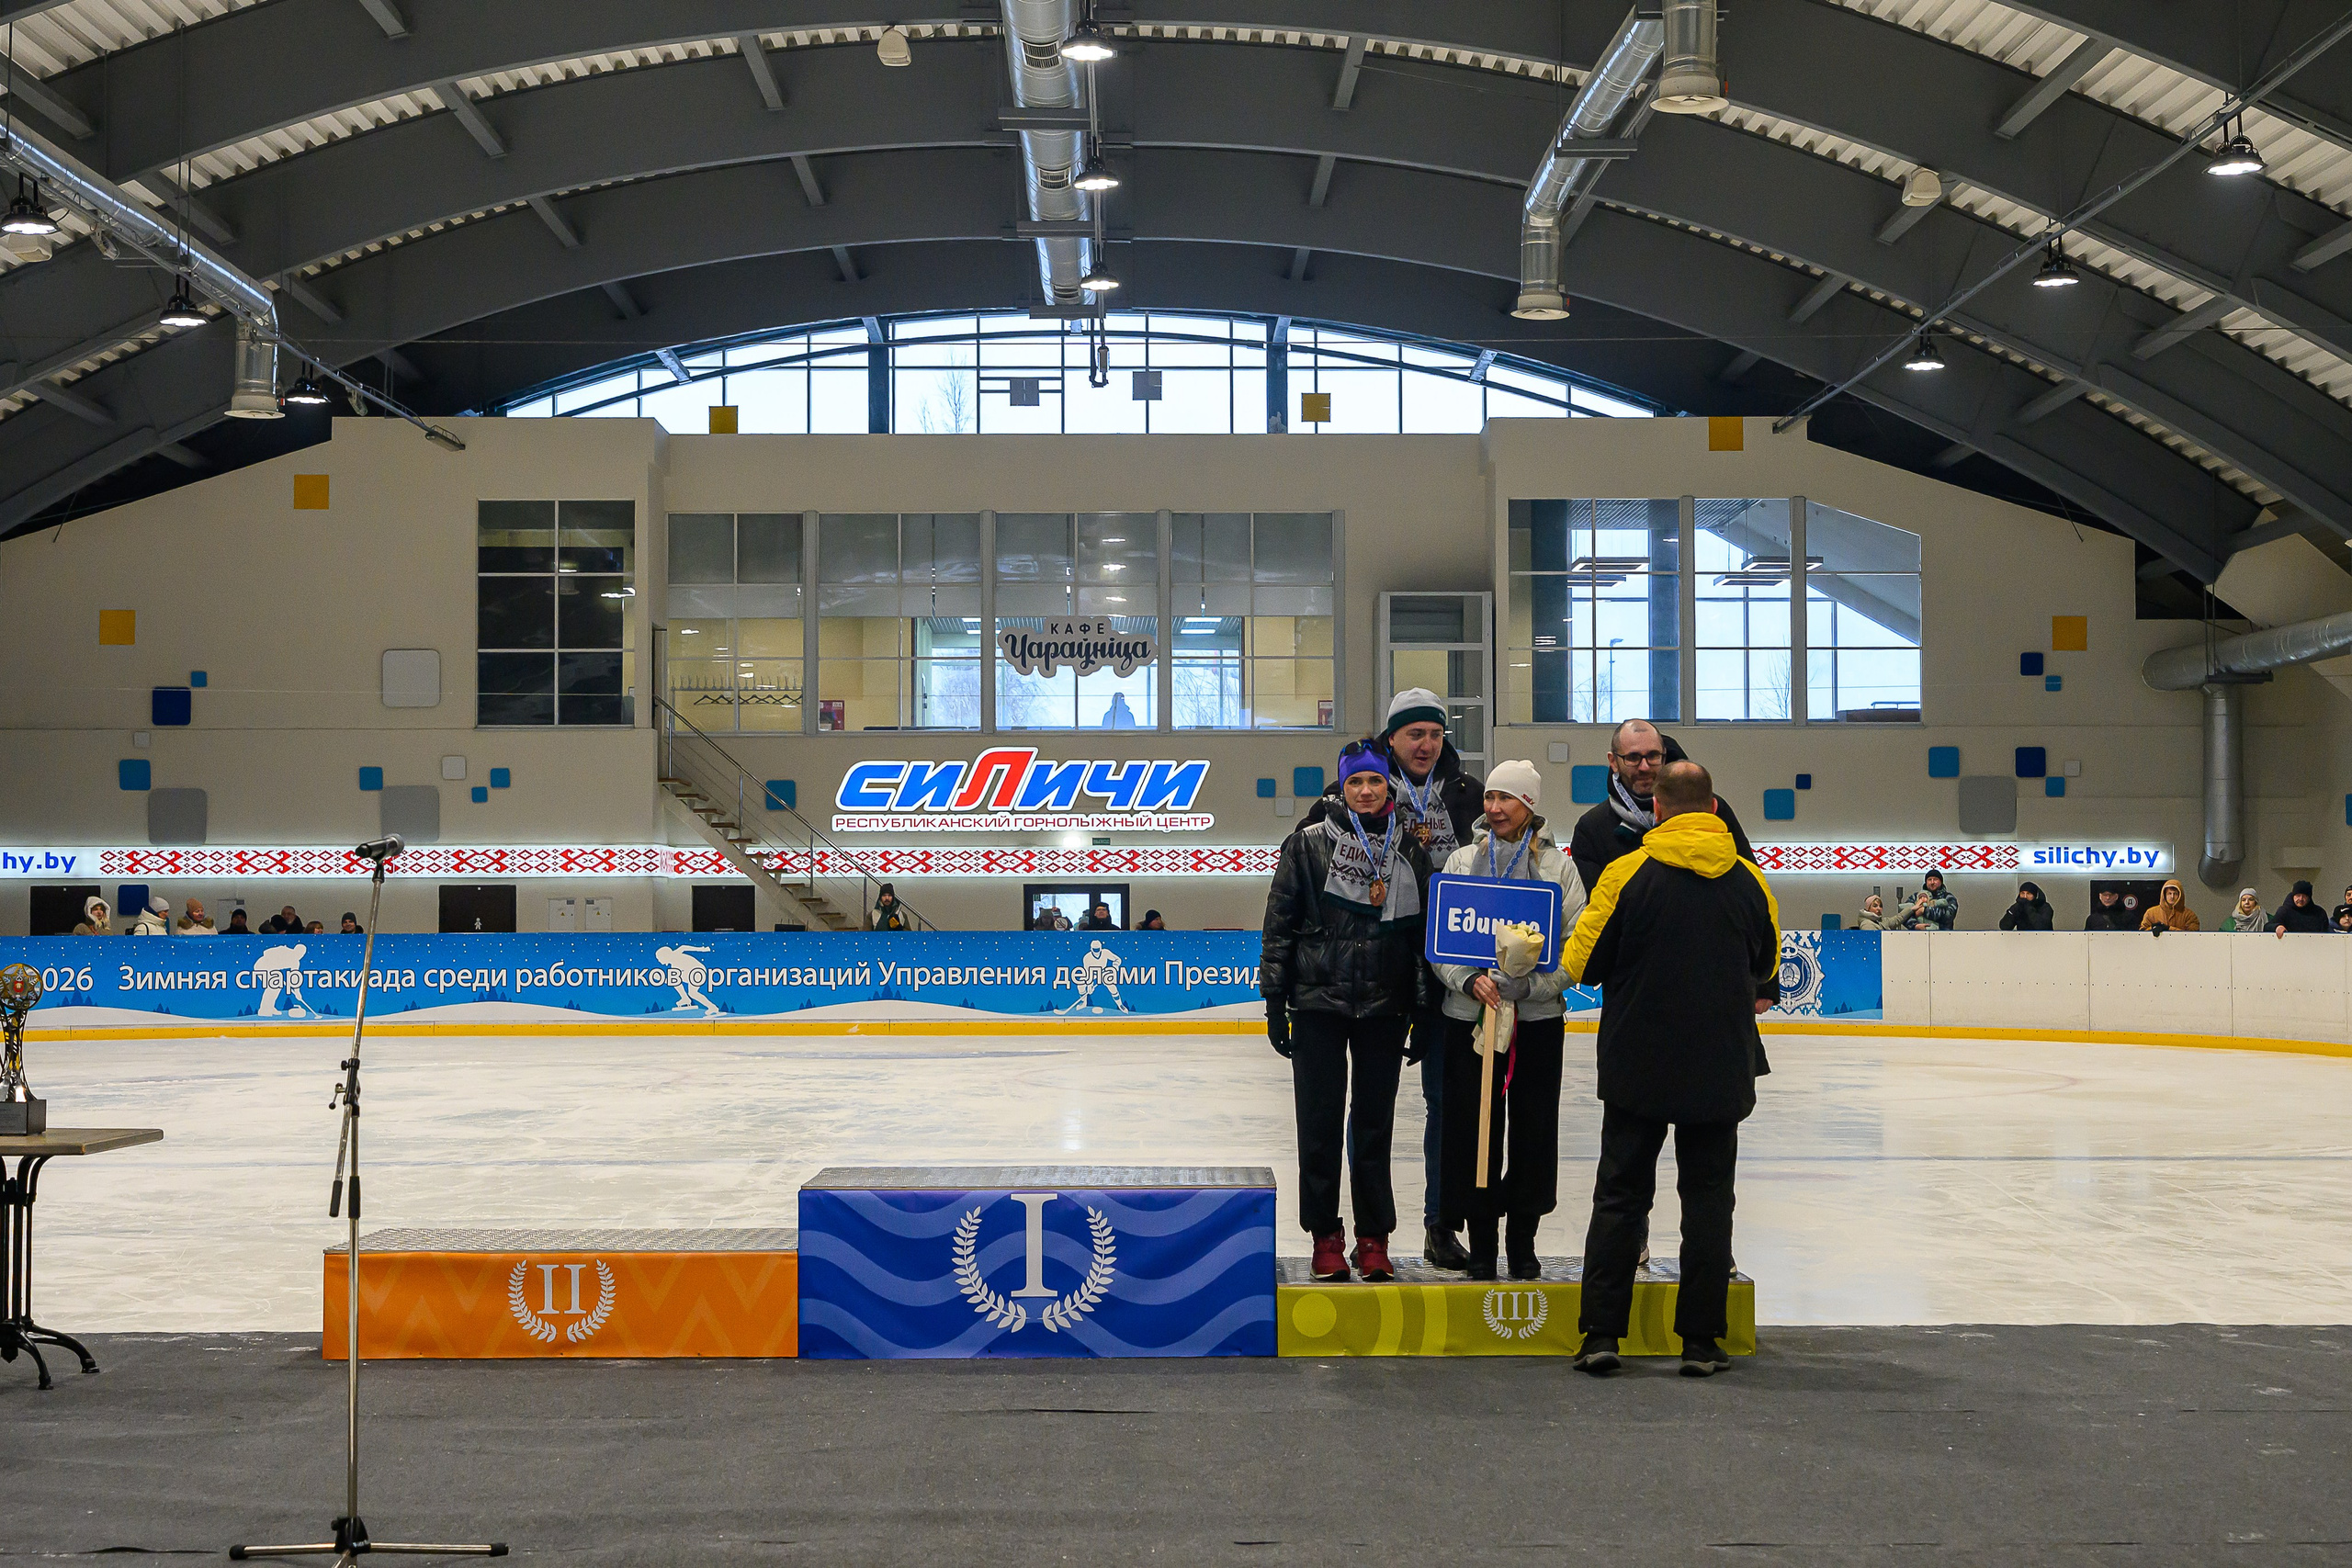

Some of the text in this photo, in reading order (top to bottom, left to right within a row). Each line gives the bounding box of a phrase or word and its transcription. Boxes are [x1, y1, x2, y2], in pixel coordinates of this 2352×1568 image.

[1050, 623, 1104, 635] КАФЕ
[1004, 633, 1151, 671] Чараўніца
[835, 814, 1211, 831] РЕСПУБЛИКАНСКИЙ ГОРНОЛЫЖНЫЙ ЦЕНТР
[2, 852, 77, 874] hy.by
[2033, 846, 2160, 868] silichy.by
[33, 966, 94, 992] 026
[118, 965, 227, 991] Зимняя
[235, 968, 415, 994] спартакиада
[424, 967, 507, 993] среди
[515, 961, 683, 993] работников
[689, 961, 871, 993] организаций
[877, 961, 1046, 992] Управления
[1053, 965, 1156, 989] делами
[1011, 1193, 1058, 1297] I
[537, 1264, 587, 1314] II
[1494, 1292, 1537, 1320] III
